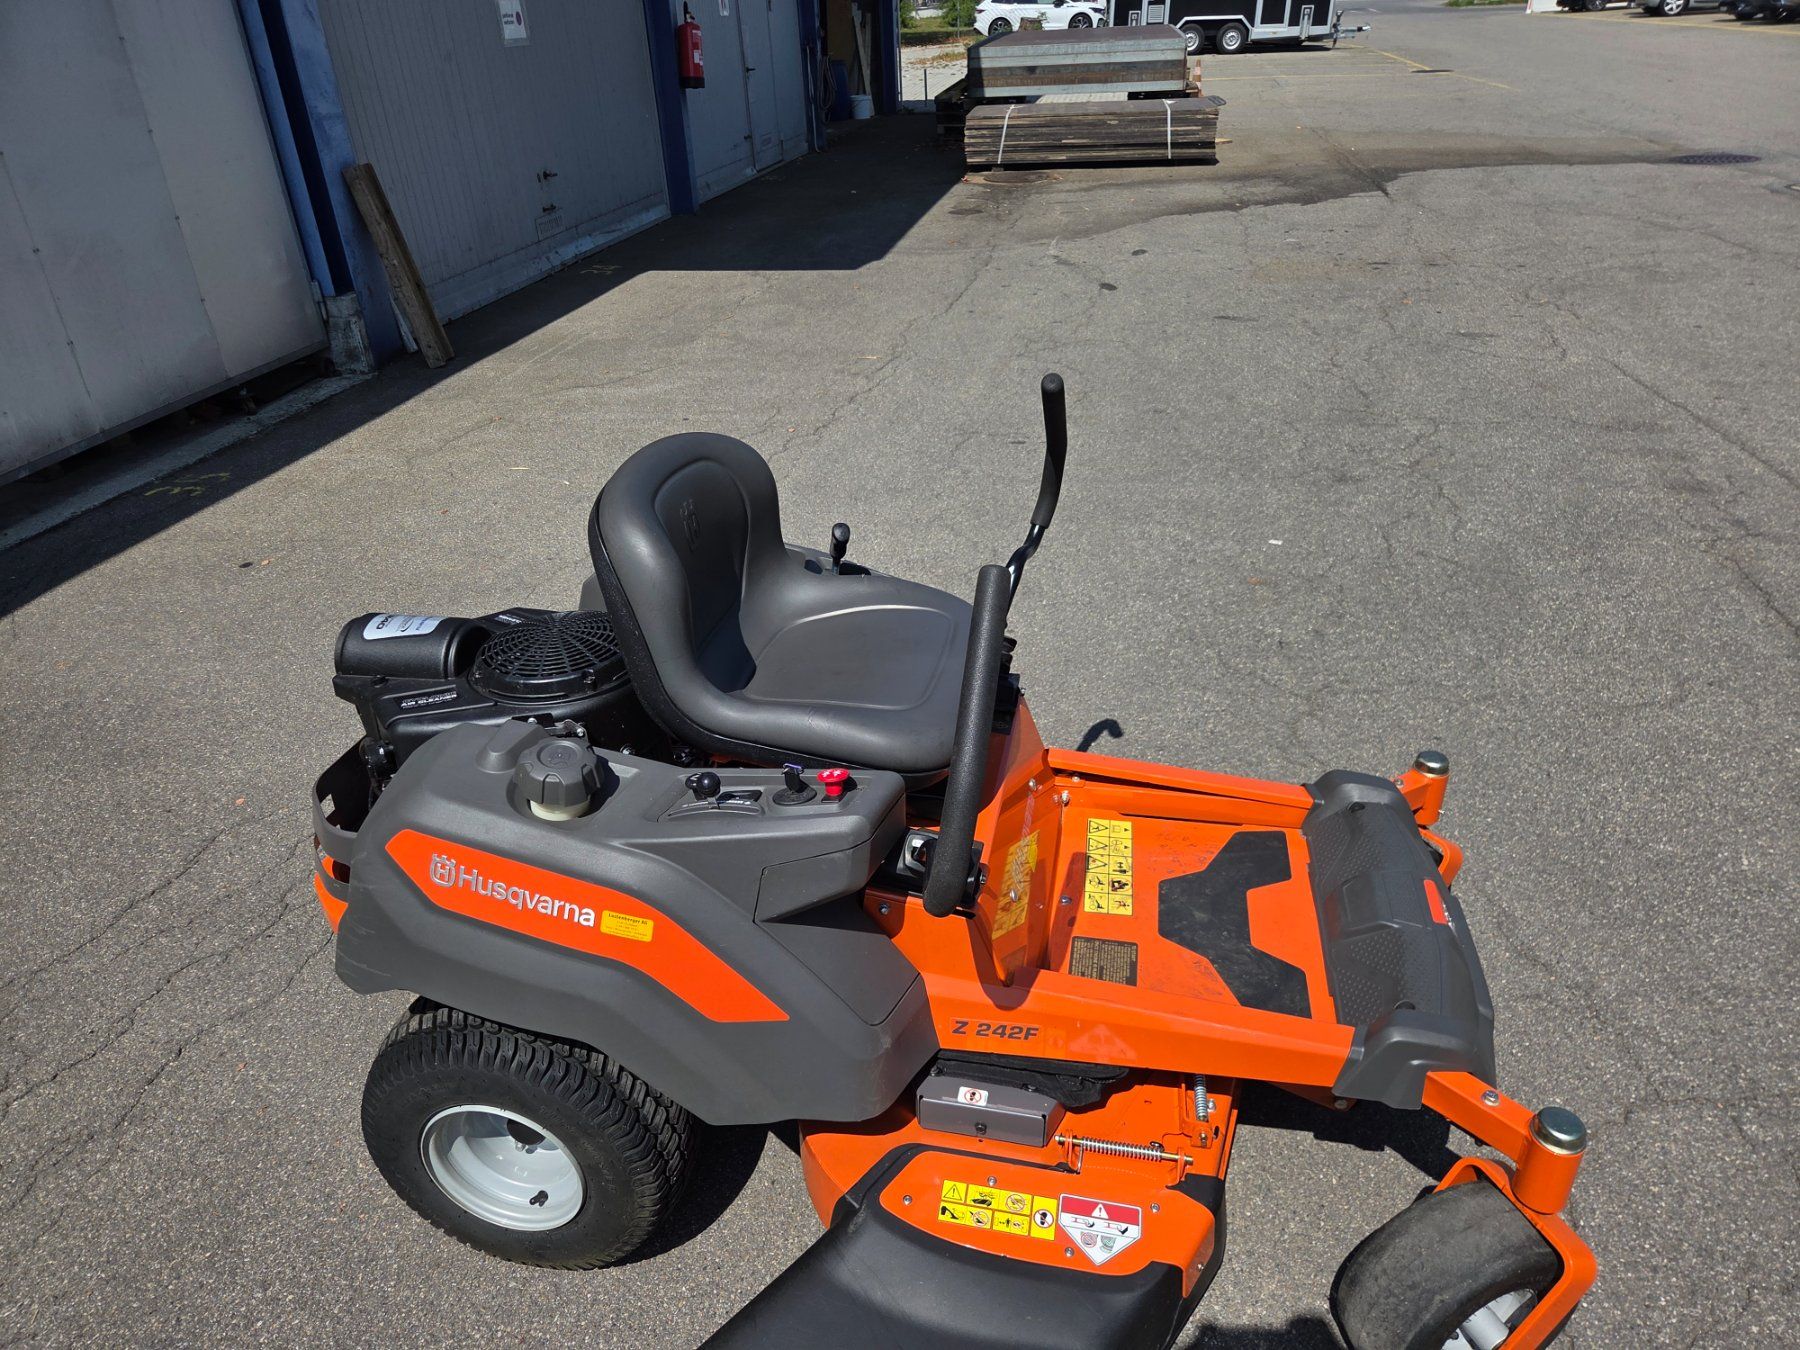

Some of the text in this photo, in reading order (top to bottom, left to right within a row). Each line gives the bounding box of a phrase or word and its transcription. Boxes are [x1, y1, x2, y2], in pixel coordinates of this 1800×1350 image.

[458, 865, 596, 927] Husqvarna
[951, 1020, 1039, 1041] Z 242F
